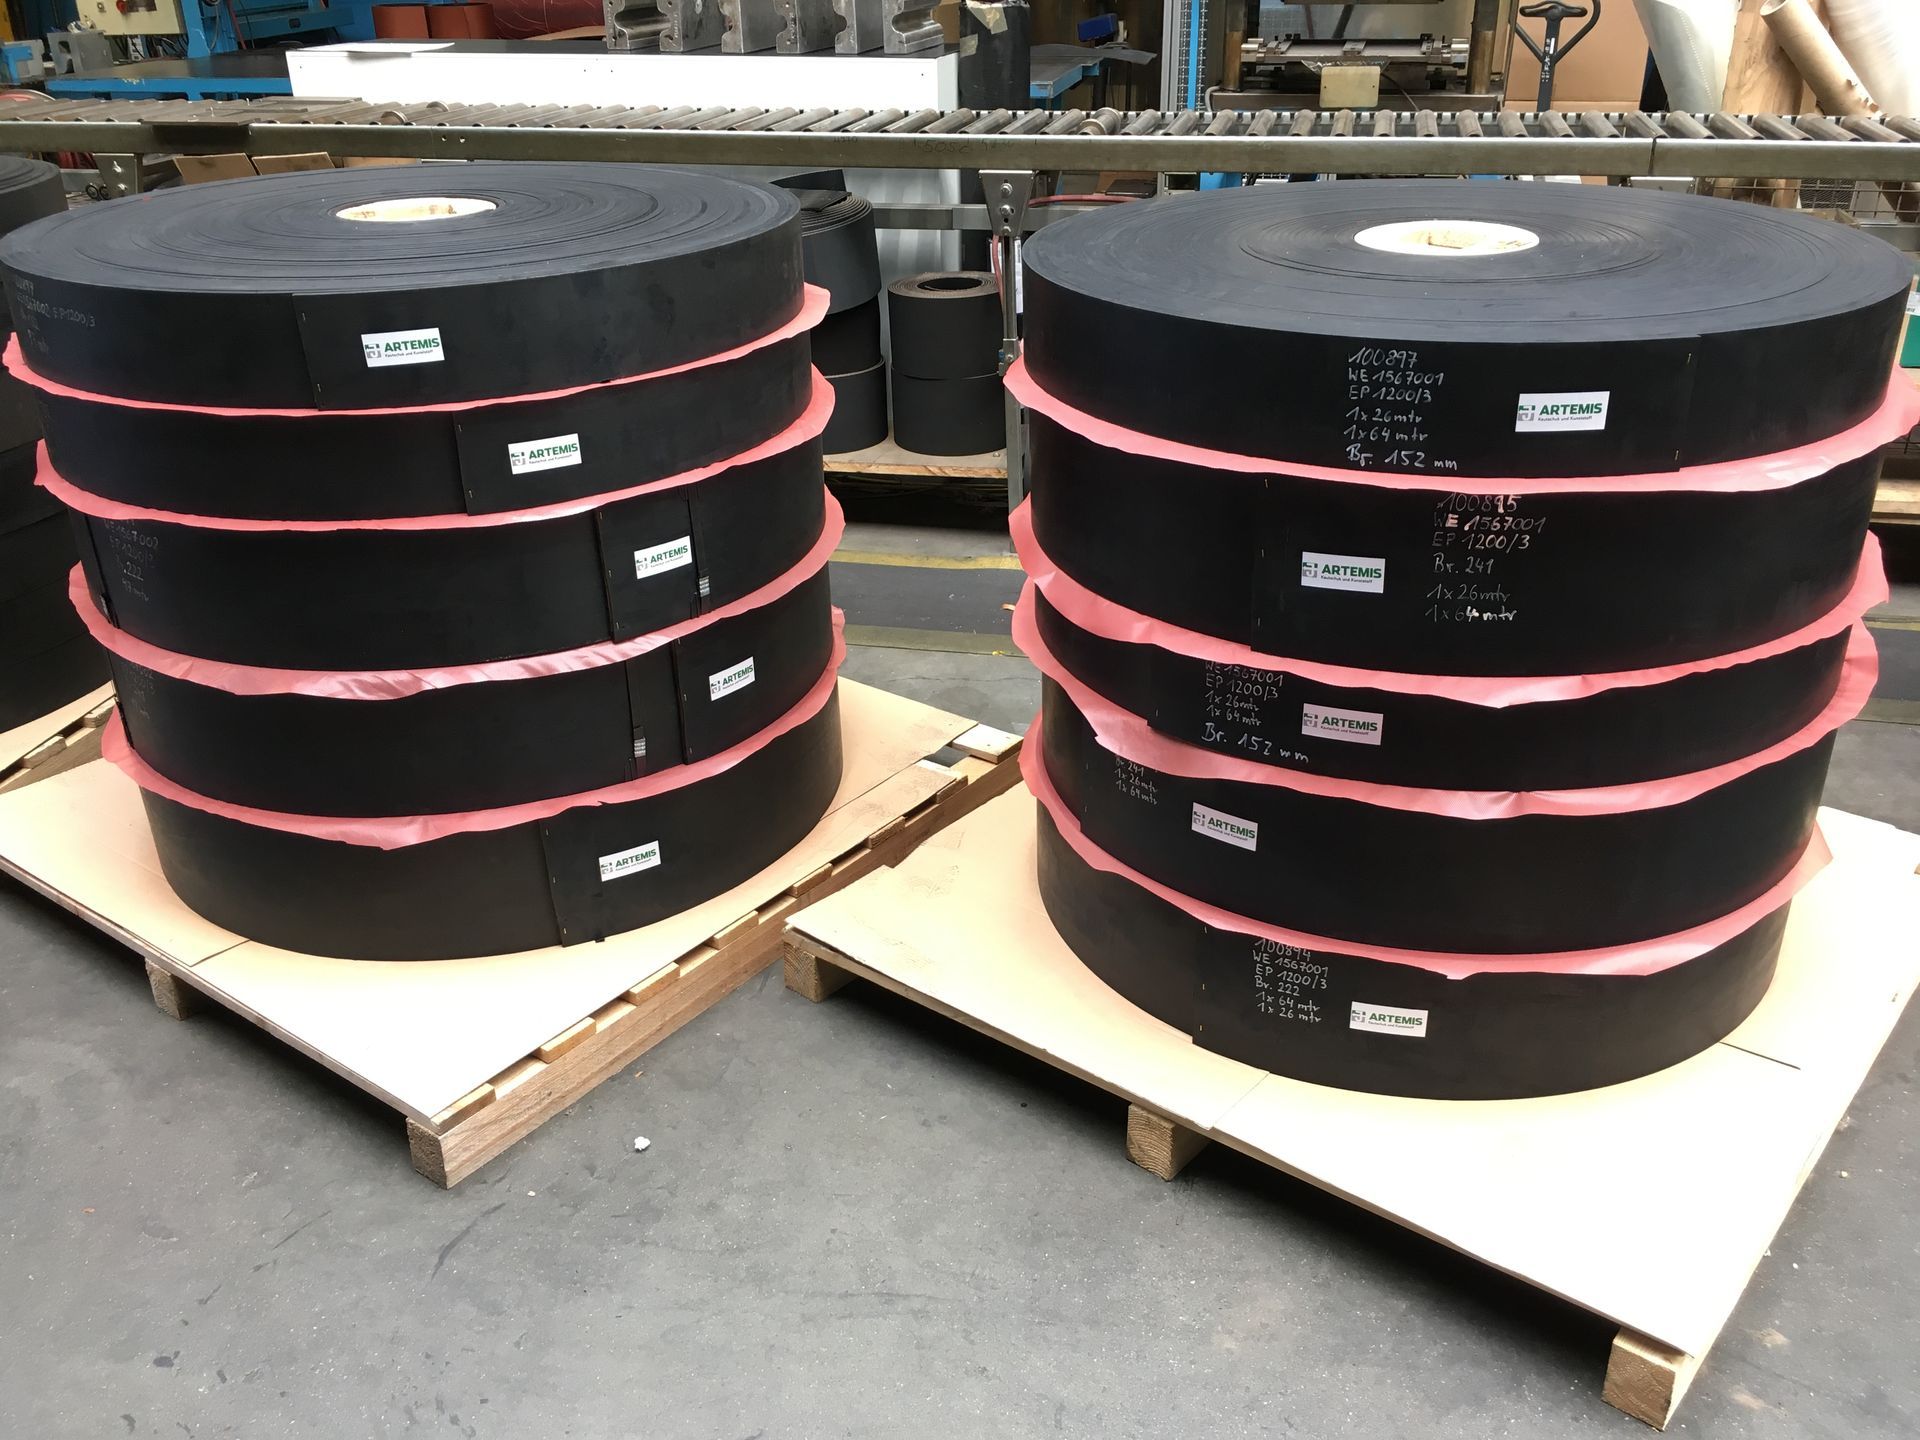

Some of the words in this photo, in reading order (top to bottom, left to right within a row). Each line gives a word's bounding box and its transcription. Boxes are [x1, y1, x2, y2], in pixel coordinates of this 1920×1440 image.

[384, 338, 440, 352] ARTEMIS
[1348, 347, 1418, 368] 100897
[1348, 368, 1369, 383] WE
[1372, 371, 1445, 386] 1567001
[1349, 385, 1370, 400] EP
[1372, 386, 1432, 404] 1200/3
[1539, 403, 1602, 415] ARTEMIS
[529, 443, 578, 460] ARTEMIS
[1384, 449, 1426, 469] 152
[1434, 459, 1458, 471] mm
[1433, 512, 1460, 527] WE
[1463, 514, 1547, 534] 1567001
[1432, 531, 1456, 546] EP
[1461, 533, 1531, 554] 1200/3
[650, 544, 688, 564] ARTEMIS
[1322, 564, 1382, 578] ARTEMIS
[1465, 556, 1495, 574] 241
[722, 664, 754, 686] ARTEMIS
[1205, 673, 1223, 688] EP
[1226, 679, 1279, 701] 1200/3
[1321, 716, 1378, 732] ARTEMIS
[1201, 722, 1227, 743] Br.
[1238, 733, 1273, 756] 152
[1208, 817, 1256, 839] ARTEMIS
[615, 848, 657, 868] ARTEMIS
[1252, 950, 1271, 964] WE
[1275, 957, 1329, 977] 1567001
[1254, 975, 1273, 990] Br.
[1277, 982, 1300, 996] 222
[1255, 964, 1273, 977] EP
[1277, 971, 1328, 989] 1200/3
[1369, 1013, 1423, 1026] ARTEMIS
